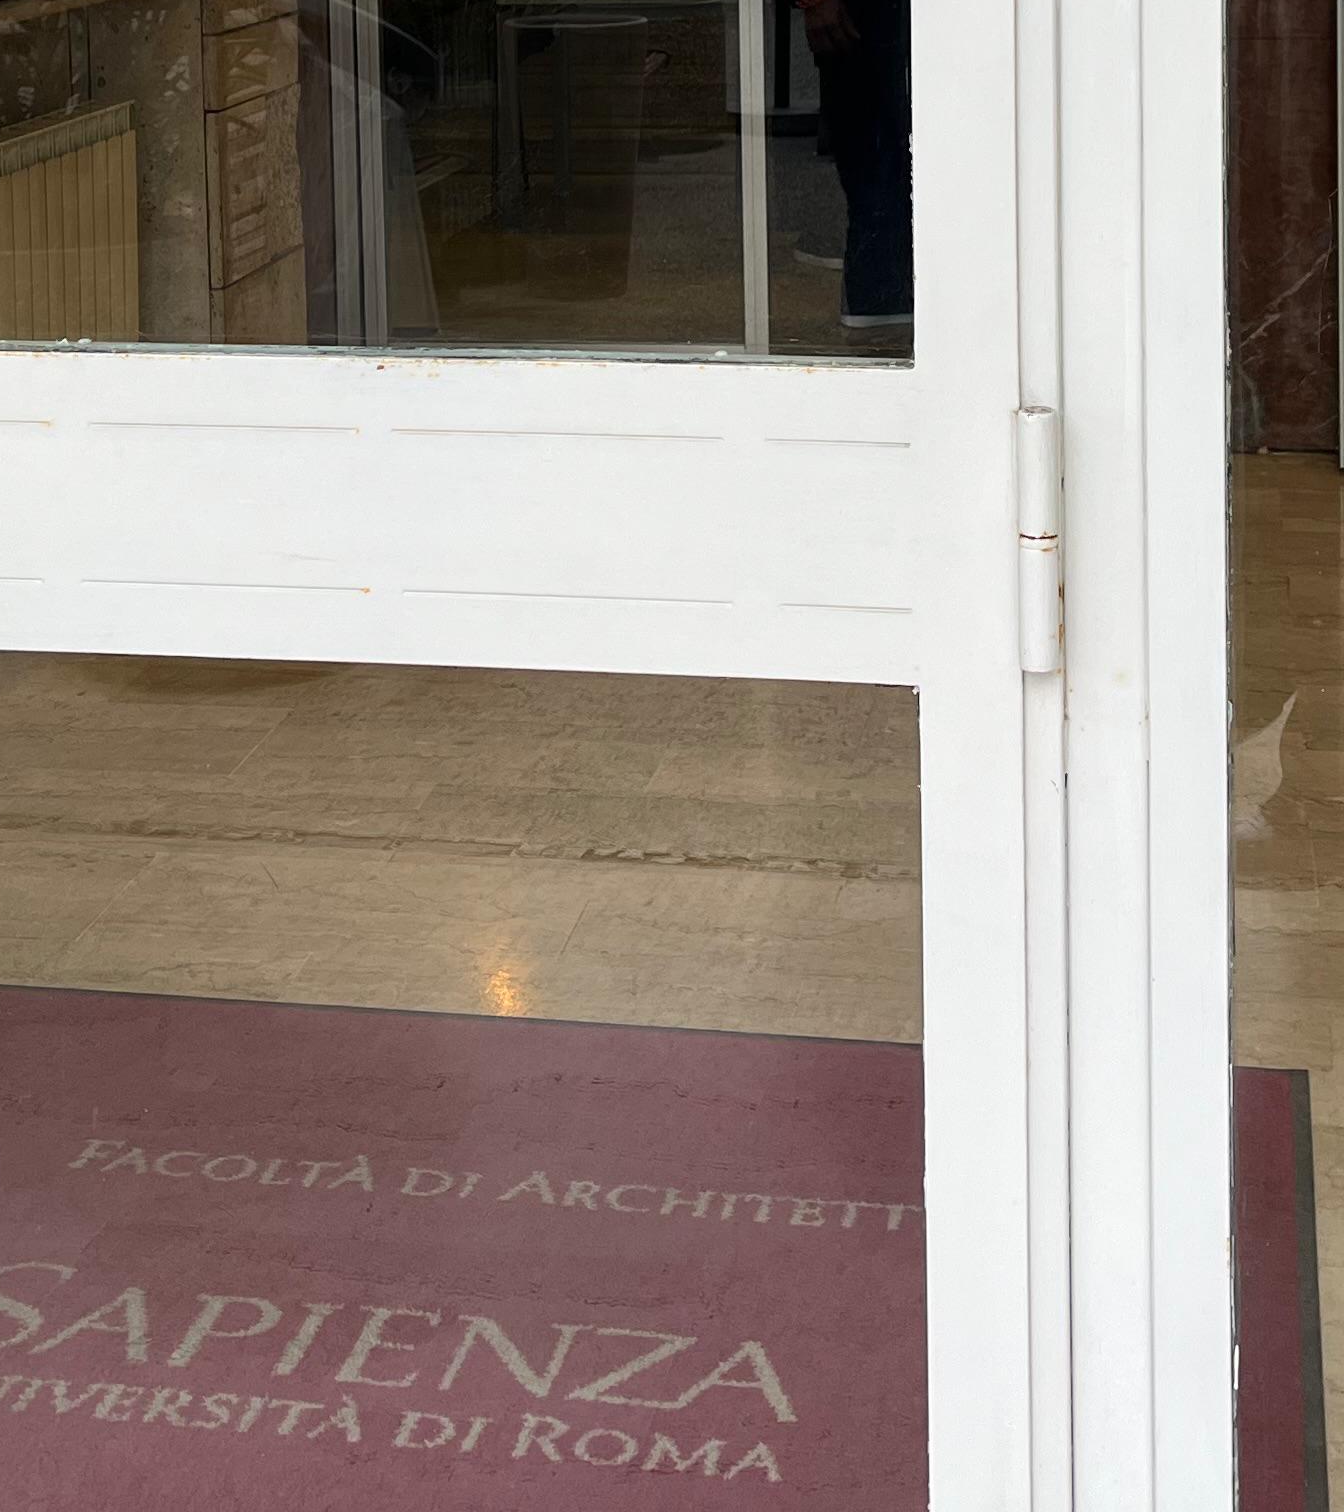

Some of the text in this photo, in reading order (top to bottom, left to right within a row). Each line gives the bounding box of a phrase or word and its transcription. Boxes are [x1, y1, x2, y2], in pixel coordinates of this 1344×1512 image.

[68, 1138, 924, 1231] FACOLTÀ DI ARCHITETT
[392, 1410, 494, 1454] DI
[511, 1412, 783, 1483] ROMA
